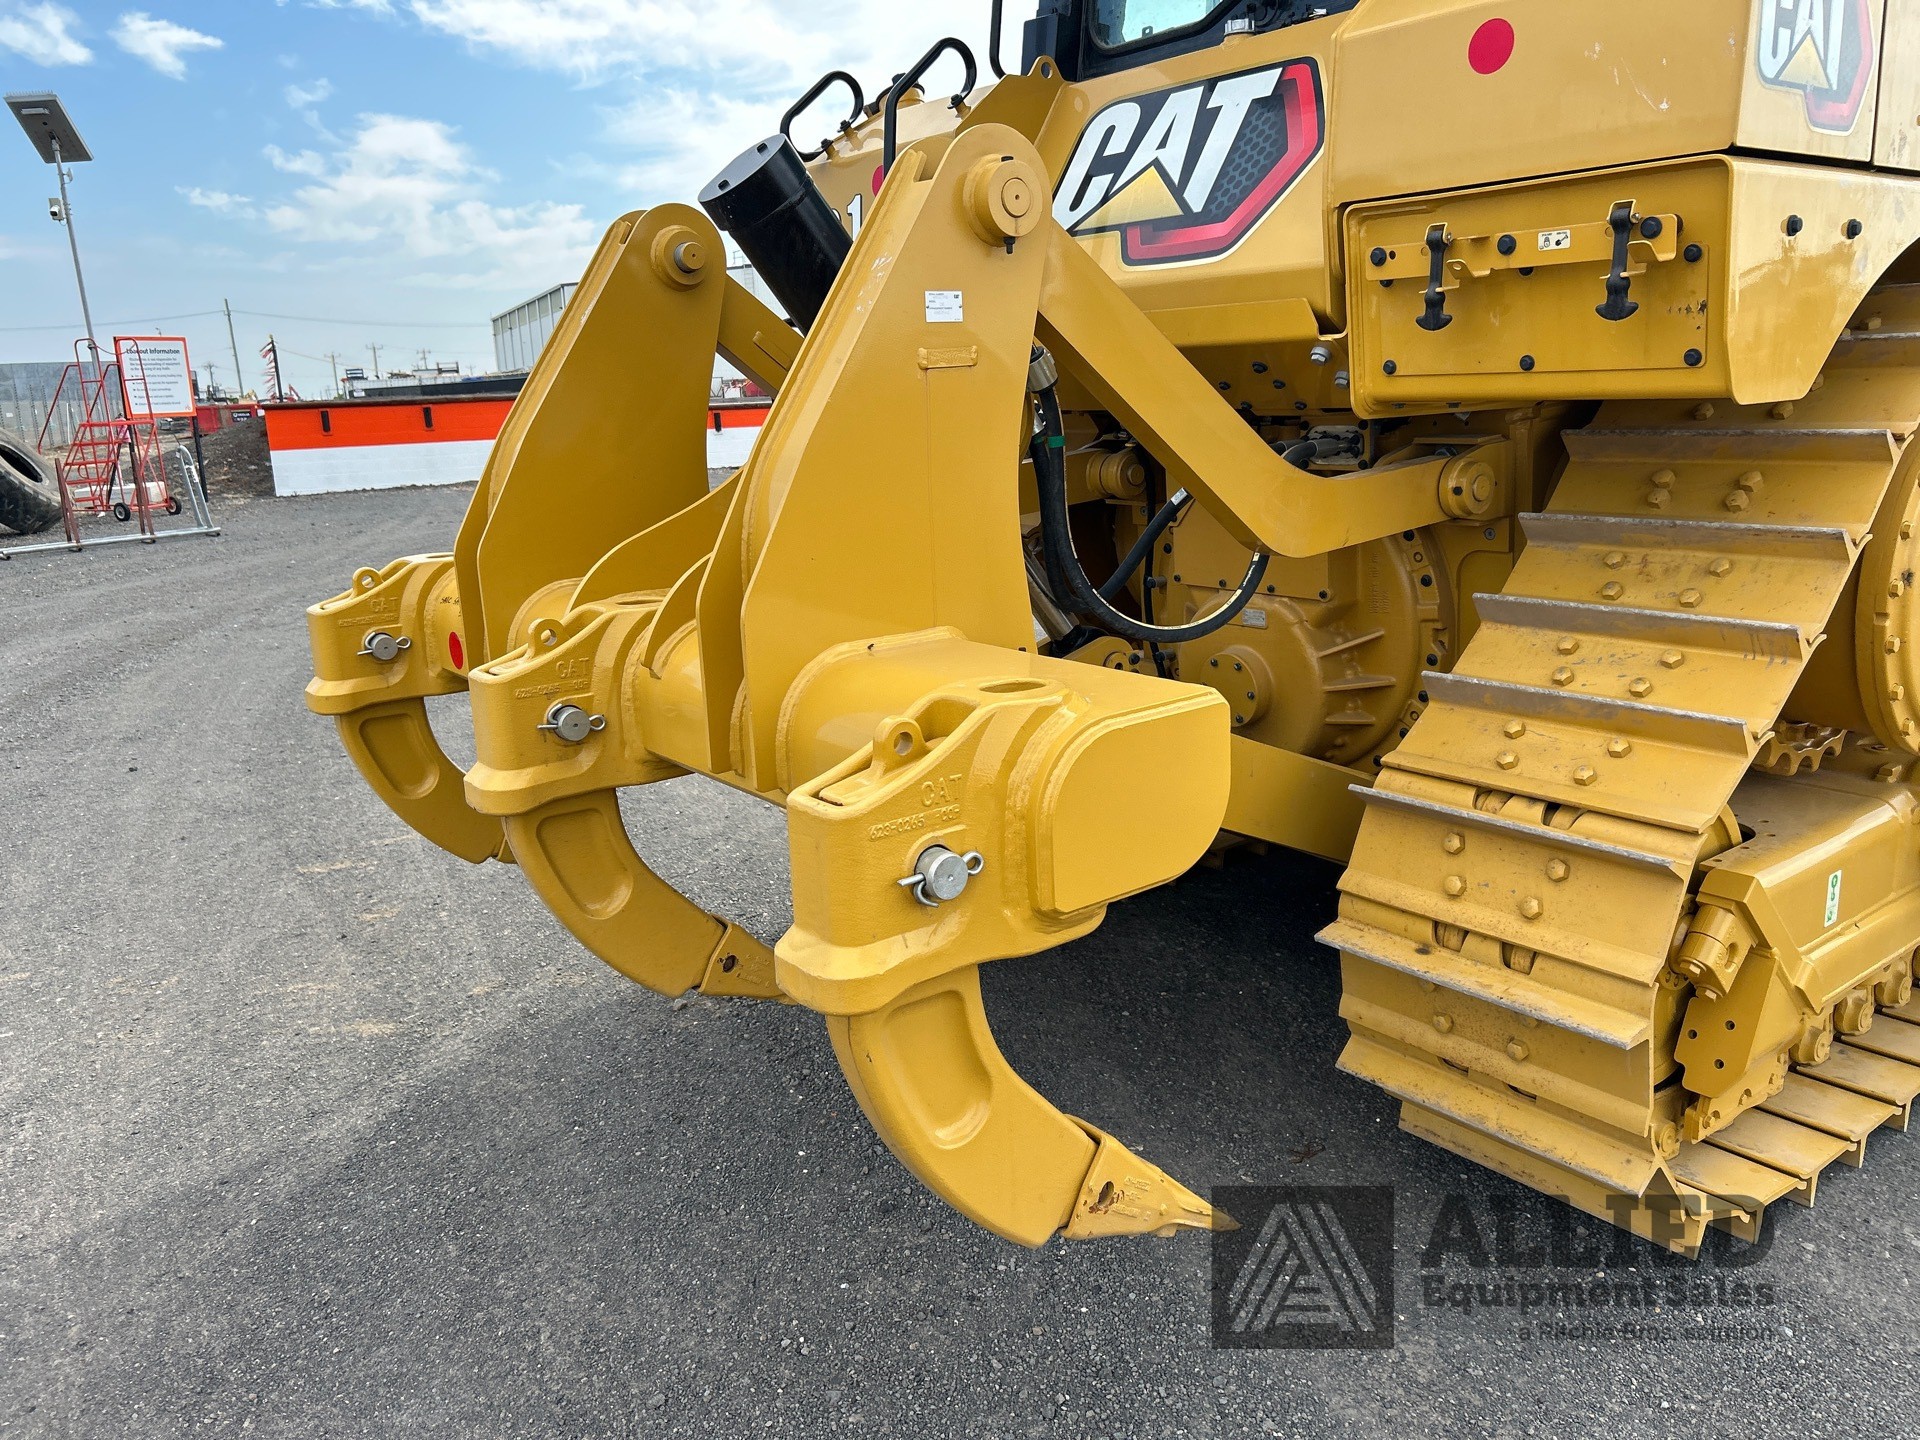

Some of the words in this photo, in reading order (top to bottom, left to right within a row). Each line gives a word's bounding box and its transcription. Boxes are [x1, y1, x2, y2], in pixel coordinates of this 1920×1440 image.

[1052, 67, 1283, 230] CAT
[556, 657, 590, 679] CAT
[920, 773, 962, 807] CAT
